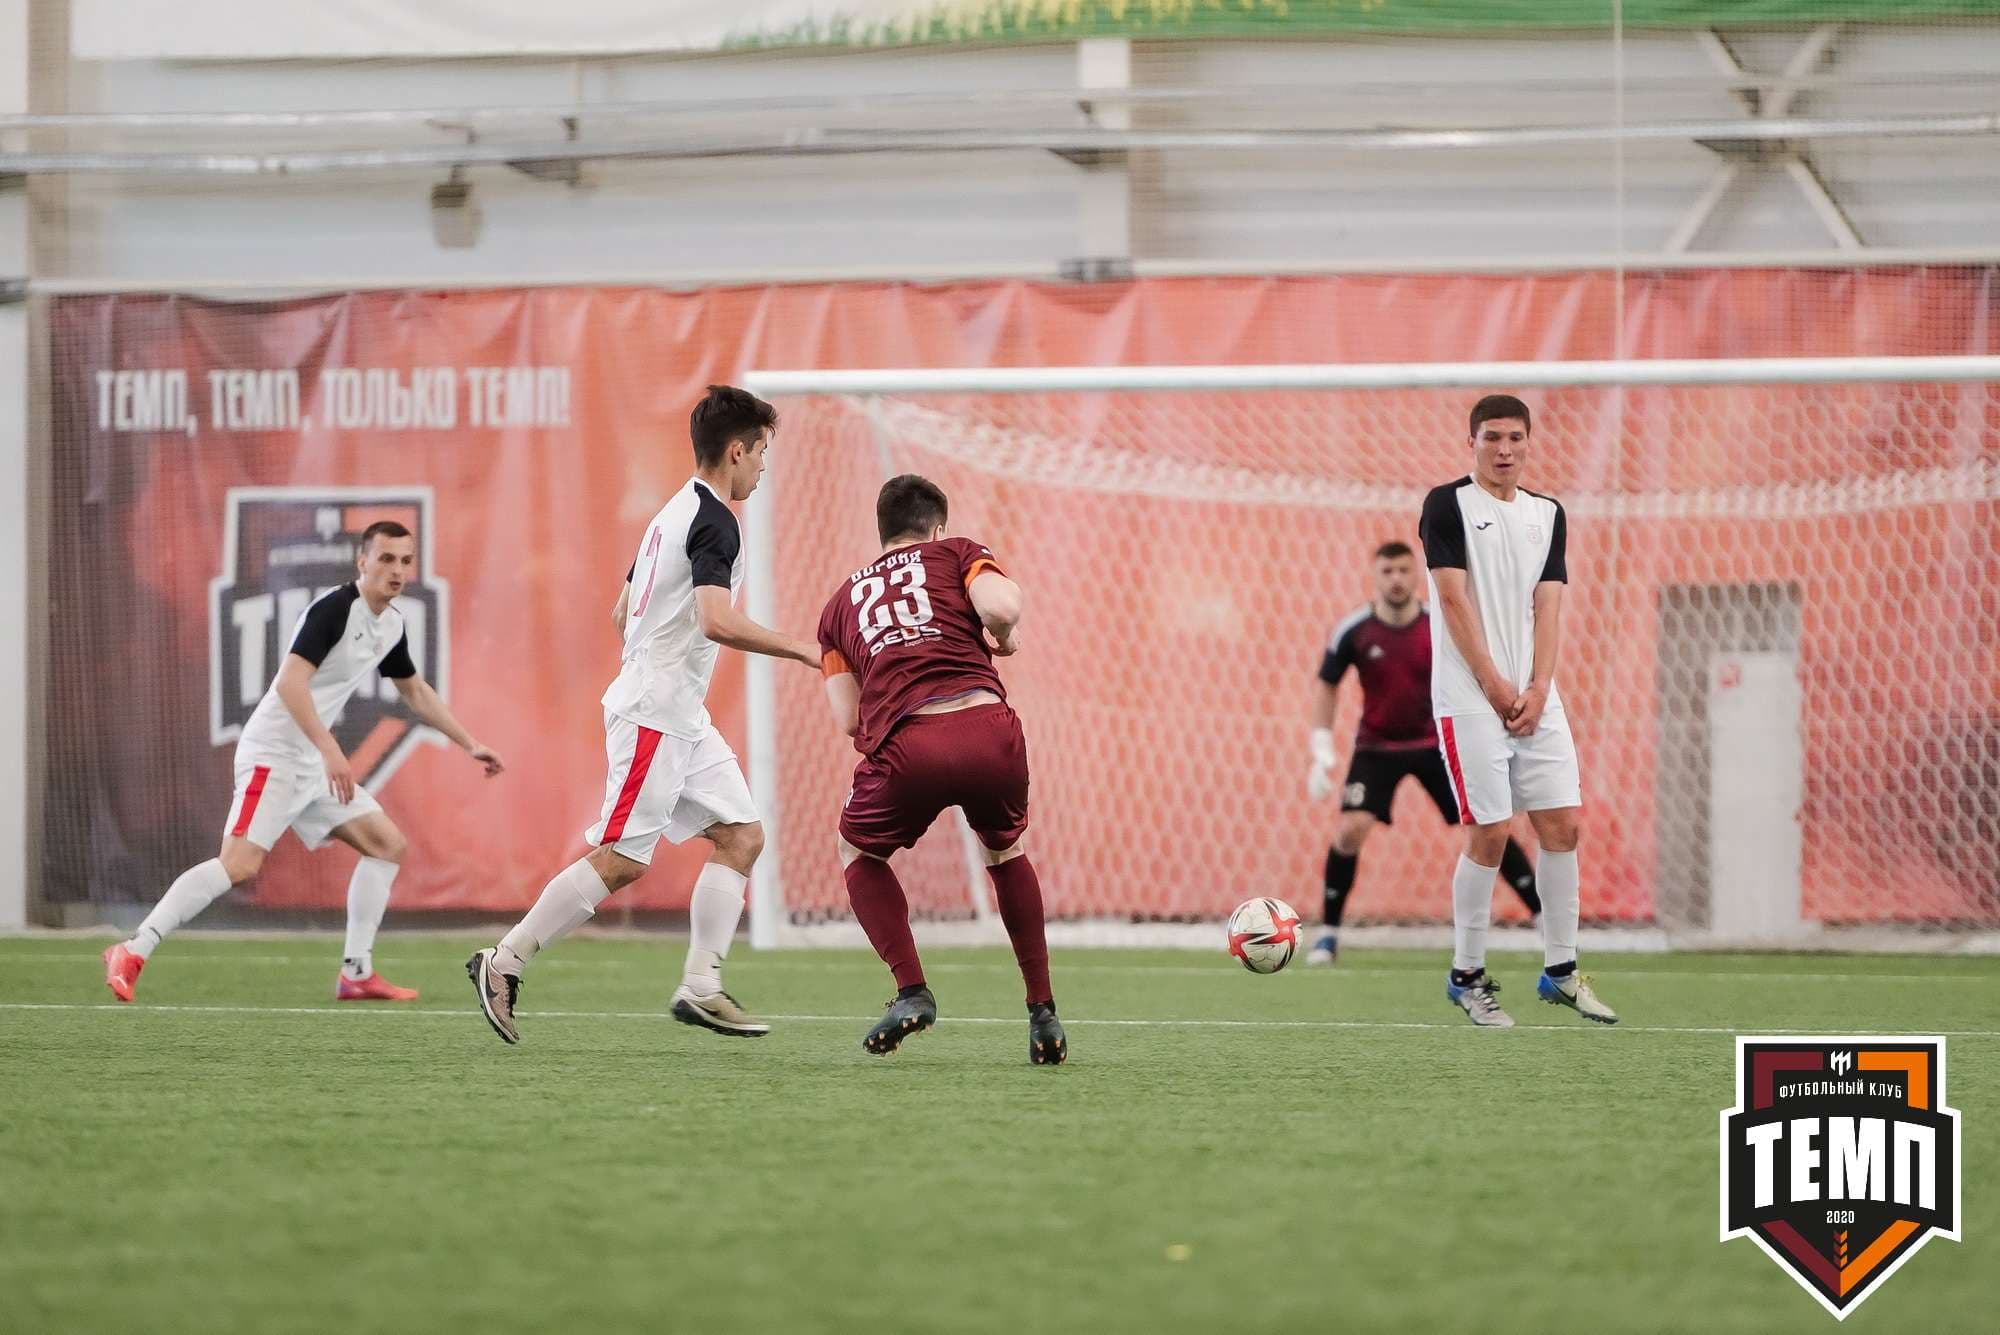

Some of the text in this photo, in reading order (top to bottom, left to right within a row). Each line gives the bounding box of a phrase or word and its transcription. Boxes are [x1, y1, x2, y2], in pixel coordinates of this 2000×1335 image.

[96, 366, 572, 436] ТЕМП, ТЕМП, ТОЛЬКО ТЕМП!
[850, 563, 934, 644] 23
